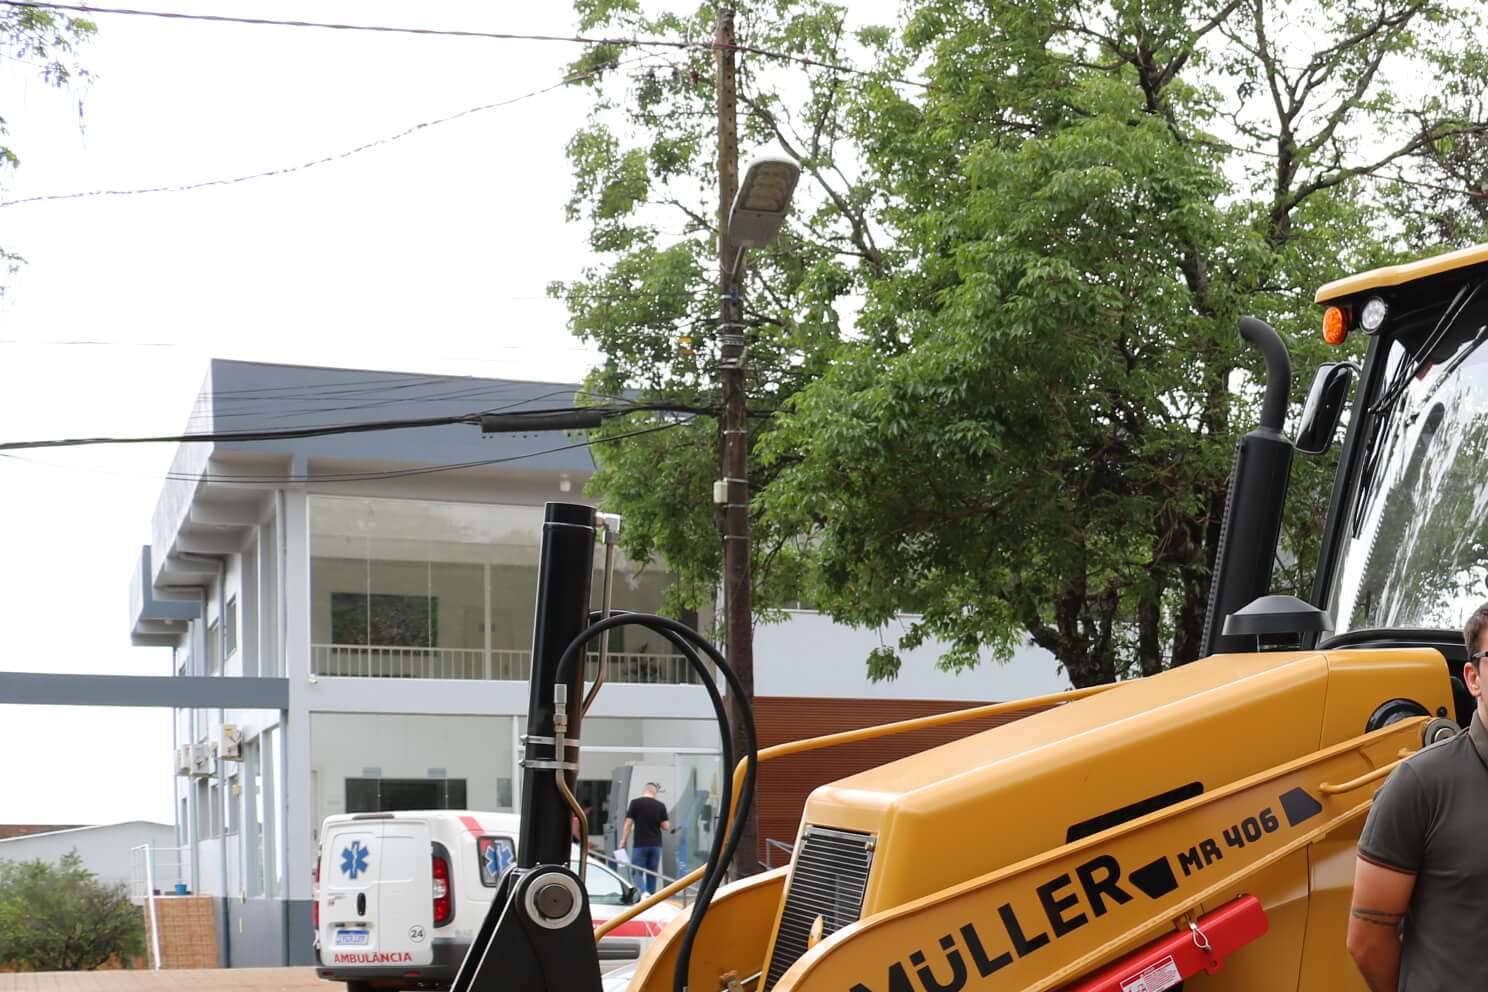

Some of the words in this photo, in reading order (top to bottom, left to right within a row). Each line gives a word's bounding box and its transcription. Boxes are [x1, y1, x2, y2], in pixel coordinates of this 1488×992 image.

[1176, 839, 1224, 877] MR
[1222, 807, 1280, 849] 406
[410, 930, 424, 939] 24
[334, 952, 412, 964] AMBULÂNCIA
